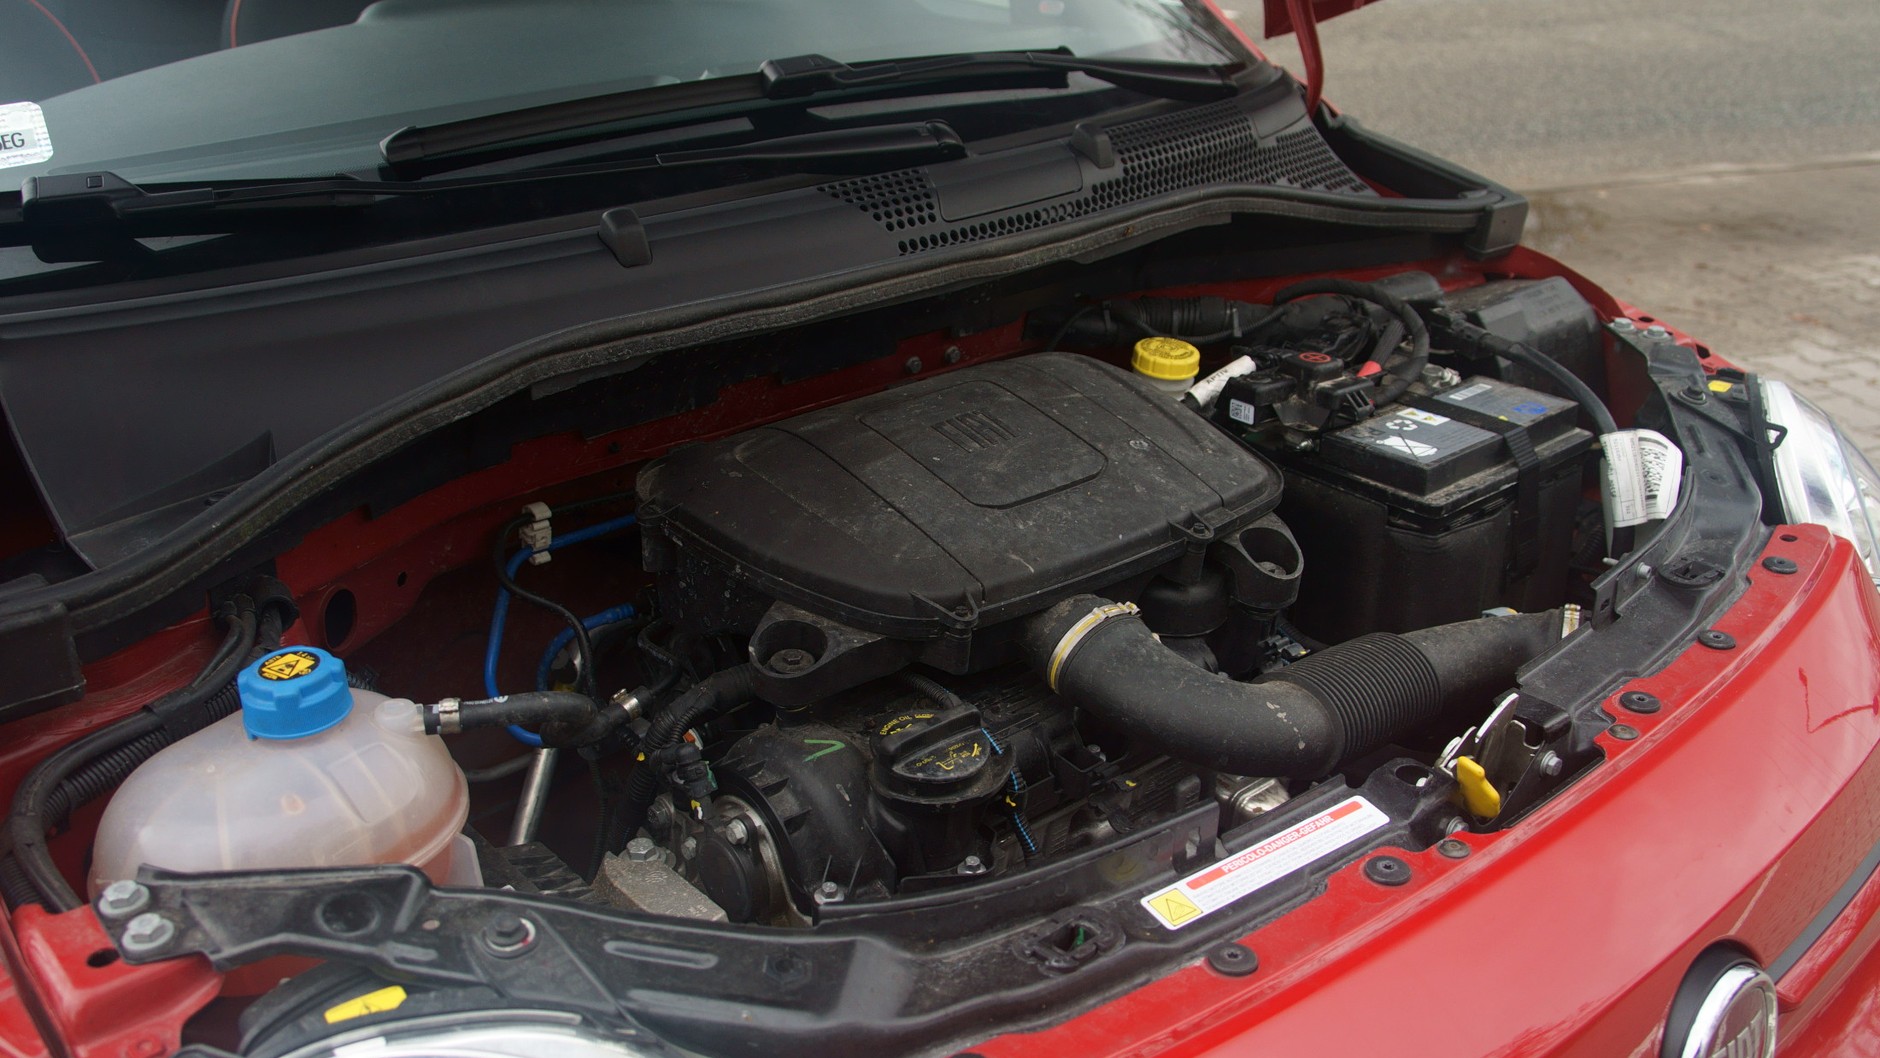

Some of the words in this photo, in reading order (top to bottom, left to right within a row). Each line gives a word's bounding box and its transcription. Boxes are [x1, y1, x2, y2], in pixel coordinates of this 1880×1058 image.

[1205, 368, 1229, 385] APTIV
[929, 410, 1020, 455] FIAT
[880, 719, 900, 735] ENGINE
[1220, 815, 1335, 874] PERICOLO-DANGER-GEFAHR
[1711, 1009, 1764, 1058] AT
